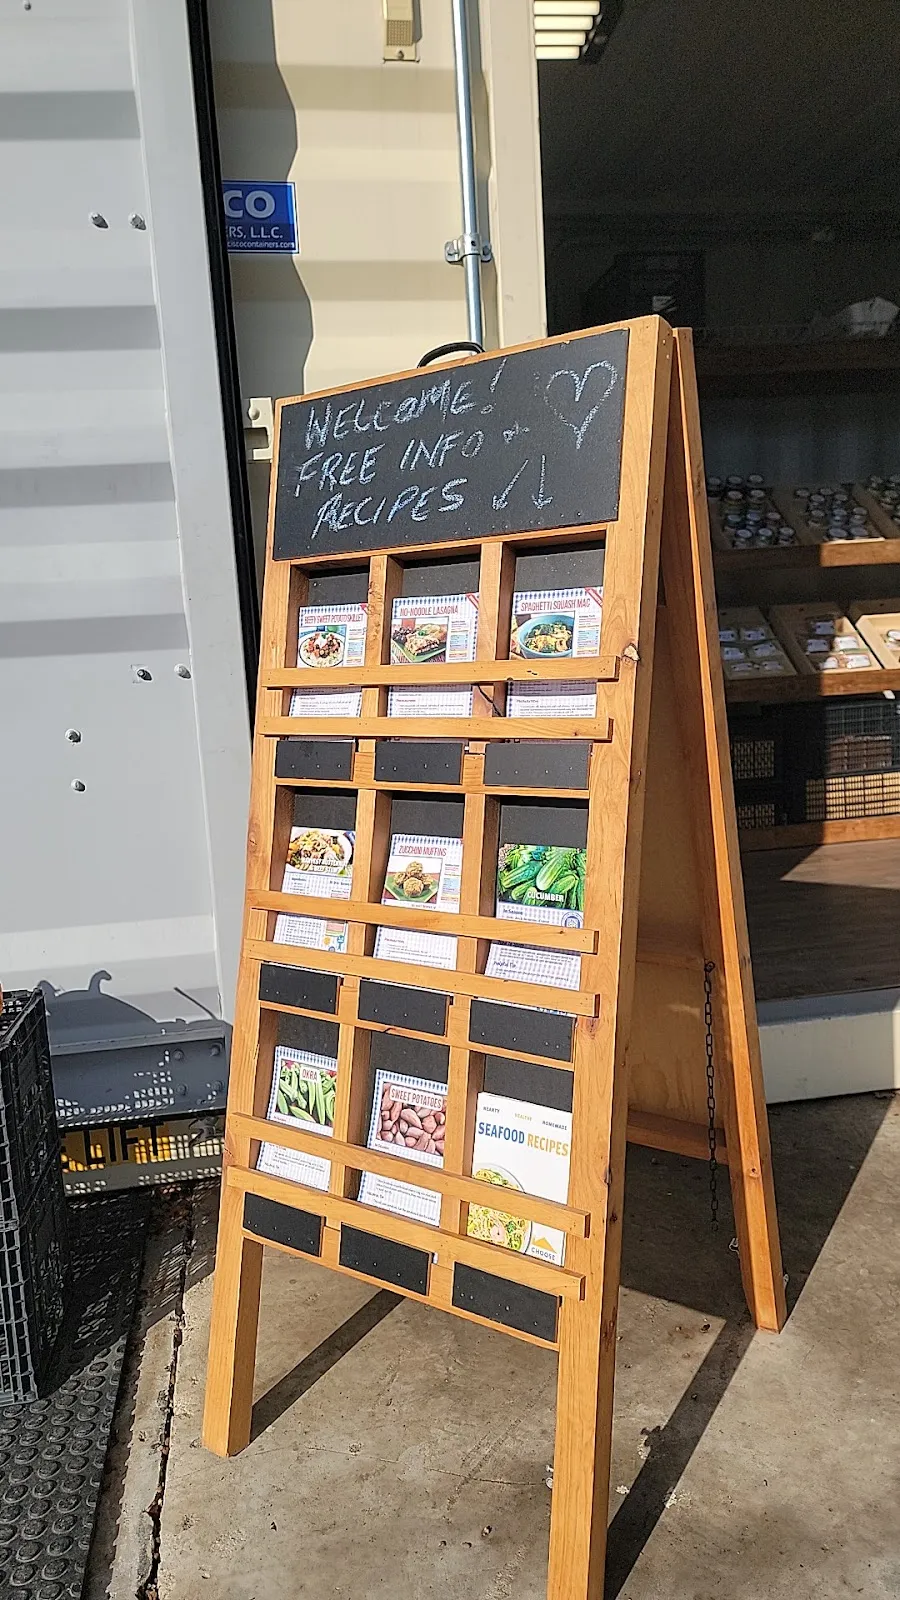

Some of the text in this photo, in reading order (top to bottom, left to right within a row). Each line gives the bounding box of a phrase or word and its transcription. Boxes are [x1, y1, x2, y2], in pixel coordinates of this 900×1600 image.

[225, 225, 283, 239] RS, L.L.C.
[304, 357, 507, 450] WELCOME!
[294, 443, 386, 498] FREE
[399, 429, 484, 471] INFO
[310, 477, 468, 540] RECIPES
[432, 605, 459, 616] LASAGNA
[520, 600, 553, 612] SPAGHETTI
[552, 599, 576, 611] SQUASH
[398, 845, 448, 857] ZUCCHINI MUFFINS
[527, 892, 564, 902] CUCUMBER
[302, 1068, 318, 1081] OKRA
[391, 1088, 442, 1110] SWEET POTATOES
[83, 1121, 164, 1165] LIFT
[478, 1122, 569, 1156] SEAFOOD RECIPES
[531, 1246, 556, 1261] CHOOSE
